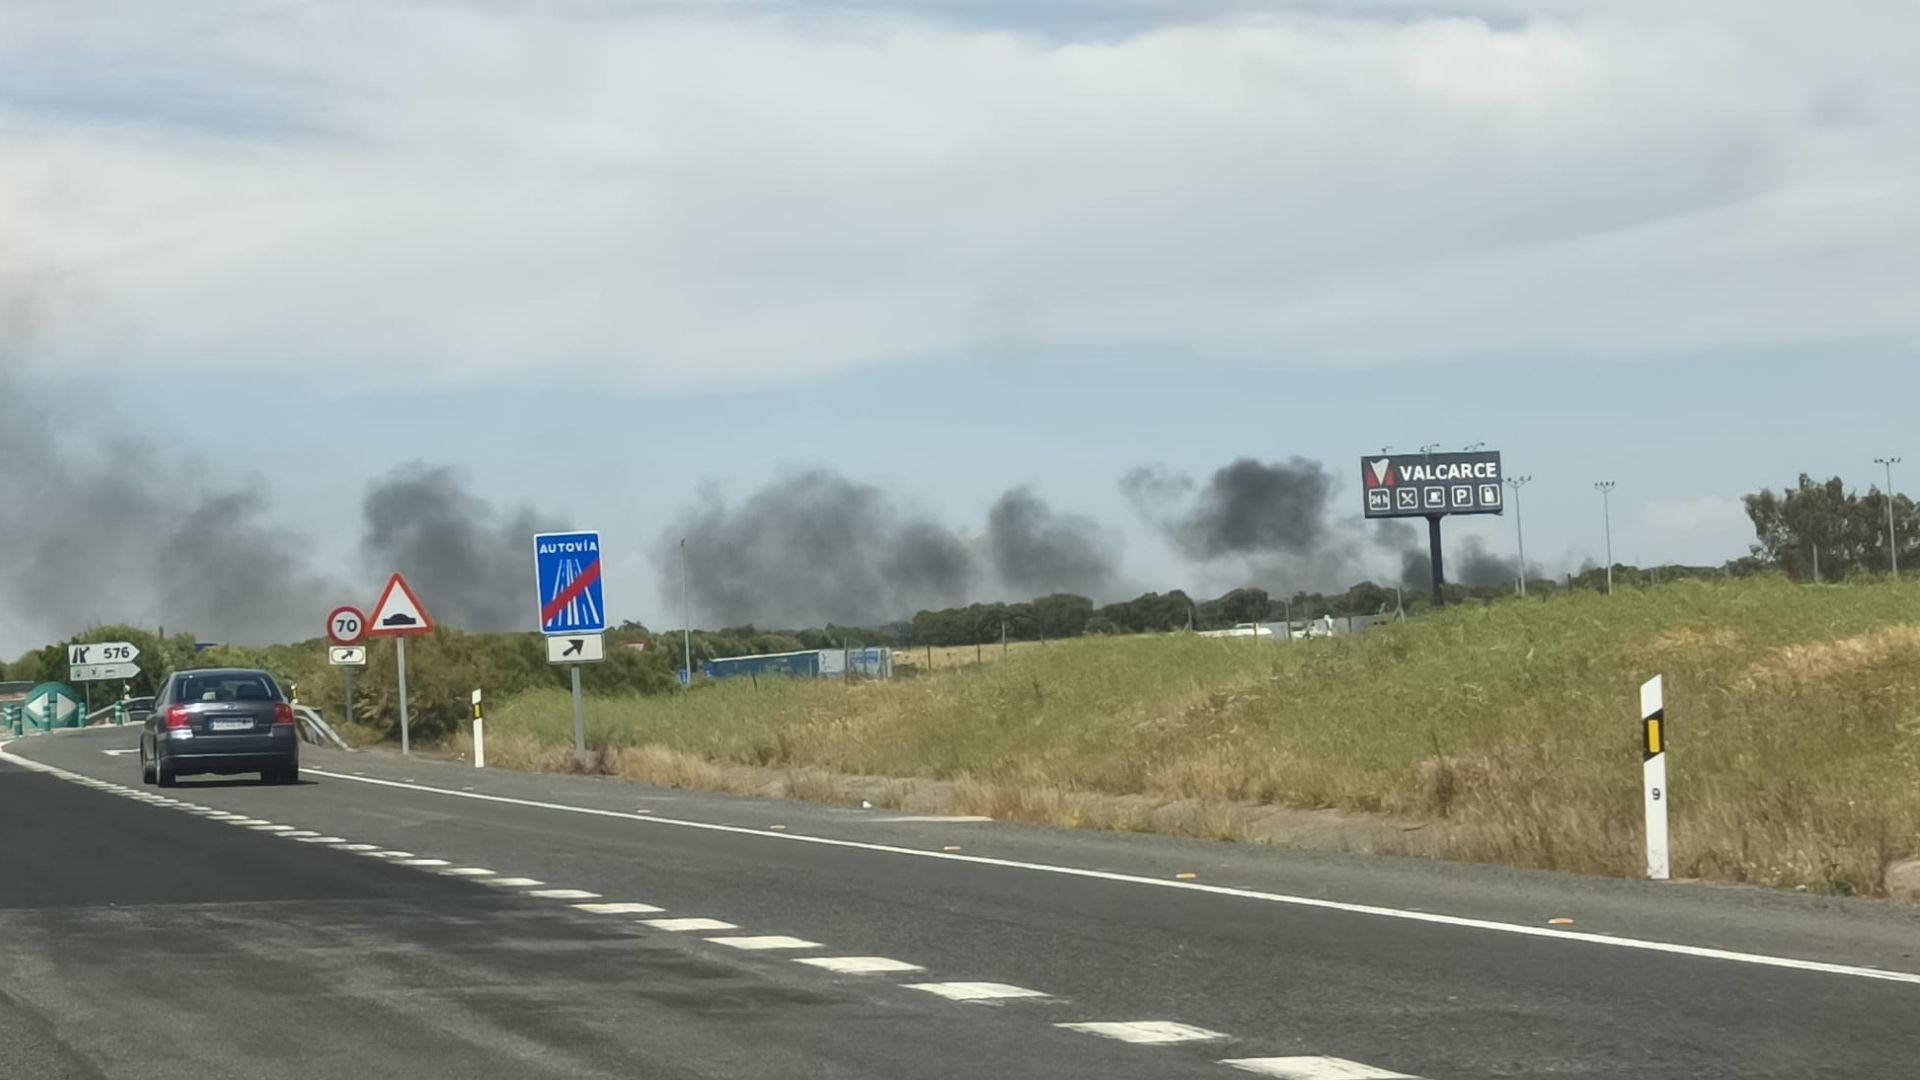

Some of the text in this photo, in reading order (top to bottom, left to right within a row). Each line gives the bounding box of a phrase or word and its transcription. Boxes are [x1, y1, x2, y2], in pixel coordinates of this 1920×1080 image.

[1400, 462, 1497, 481] VALCARCE
[1456, 489, 1467, 503] P
[539, 539, 597, 553] AUTOVÍA
[335, 619, 357, 632] 70
[104, 646, 129, 659] 576
[1652, 787, 1660, 800] 9
